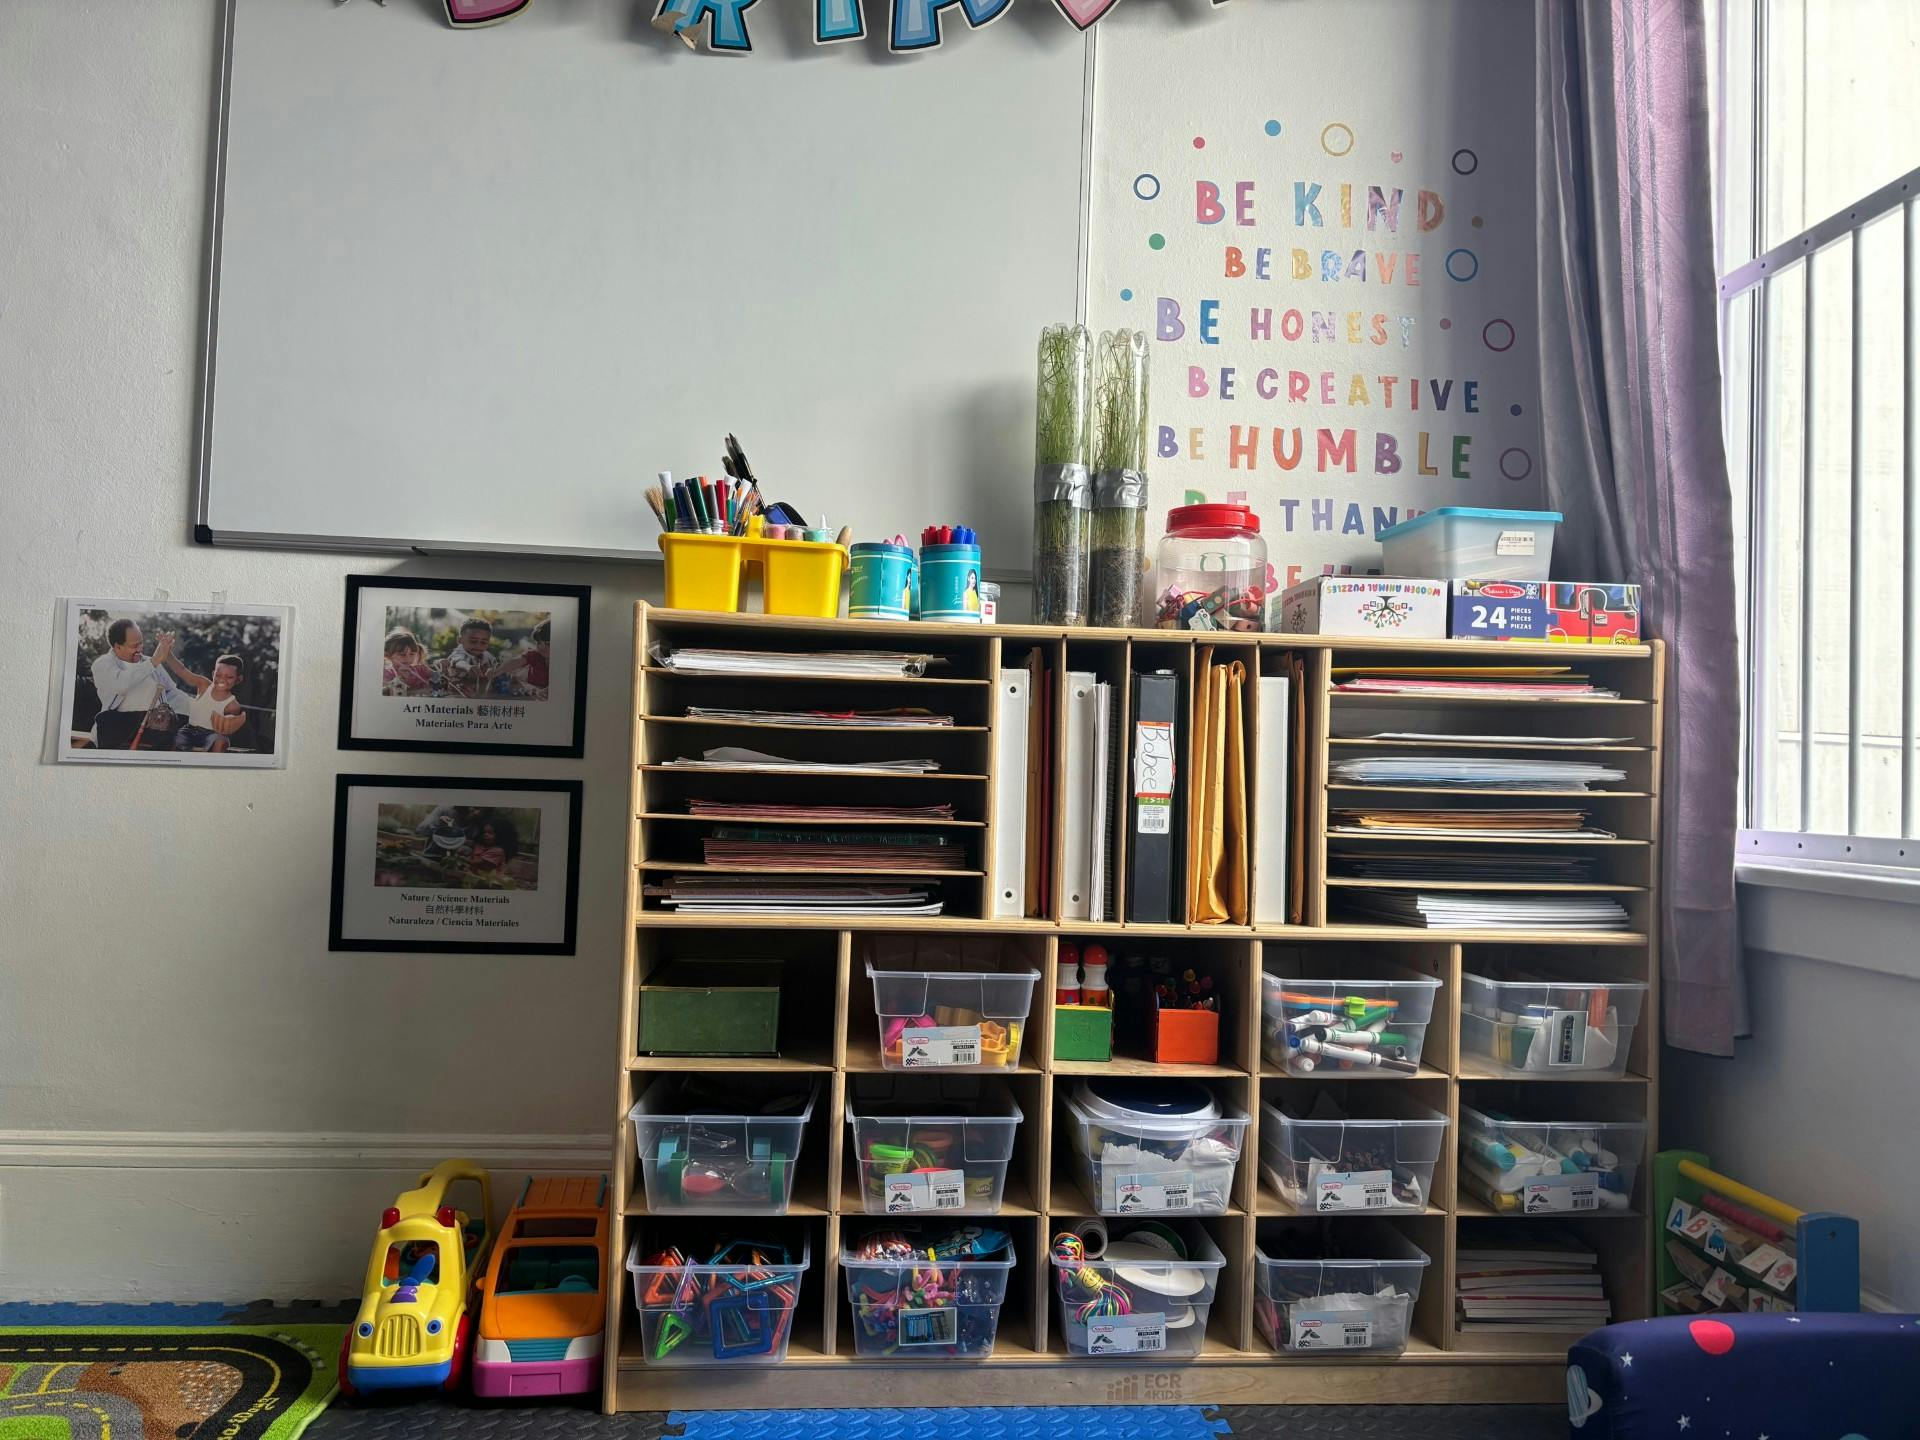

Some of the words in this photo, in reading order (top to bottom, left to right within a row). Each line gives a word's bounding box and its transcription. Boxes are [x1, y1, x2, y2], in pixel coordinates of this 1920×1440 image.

[1195, 180, 1256, 226] BE
[1293, 181, 1446, 233] KIND
[1225, 246, 1272, 280] BE
[1291, 248, 1421, 286] BRAVE
[1156, 297, 1220, 345] BE
[1250, 307, 1417, 349] HONEST
[1188, 366, 1236, 401] BE
[1256, 367, 1480, 414] CREATIVE
[1158, 425, 1205, 459] BE
[1229, 425, 1472, 479] HUMBLE
[1326, 583, 1365, 593] PUZZLES
[1367, 583, 1402, 593] ANIMAL
[1404, 585, 1441, 596] WOODEN
[1471, 605, 1507, 629] 24
[403, 703, 421, 713] Art
[423, 704, 474, 715] Materials
[415, 718, 465, 729] Materiales
[467, 720, 489, 729] Para
[491, 721, 513, 730] Arte
[400, 893, 430, 902] Nature
[437, 894, 468, 903] Science
[470, 895, 510, 904] Materials
[388, 916, 435, 925] Naturaleza
[441, 917, 473, 927] Ciencia
[475, 918, 520, 928] Materiales
[1670, 1209, 1683, 1228] A
[1686, 1218, 1708, 1233] B
[1144, 1373, 1182, 1389] ECR
[1143, 1390, 1183, 1401] 4KIDS
